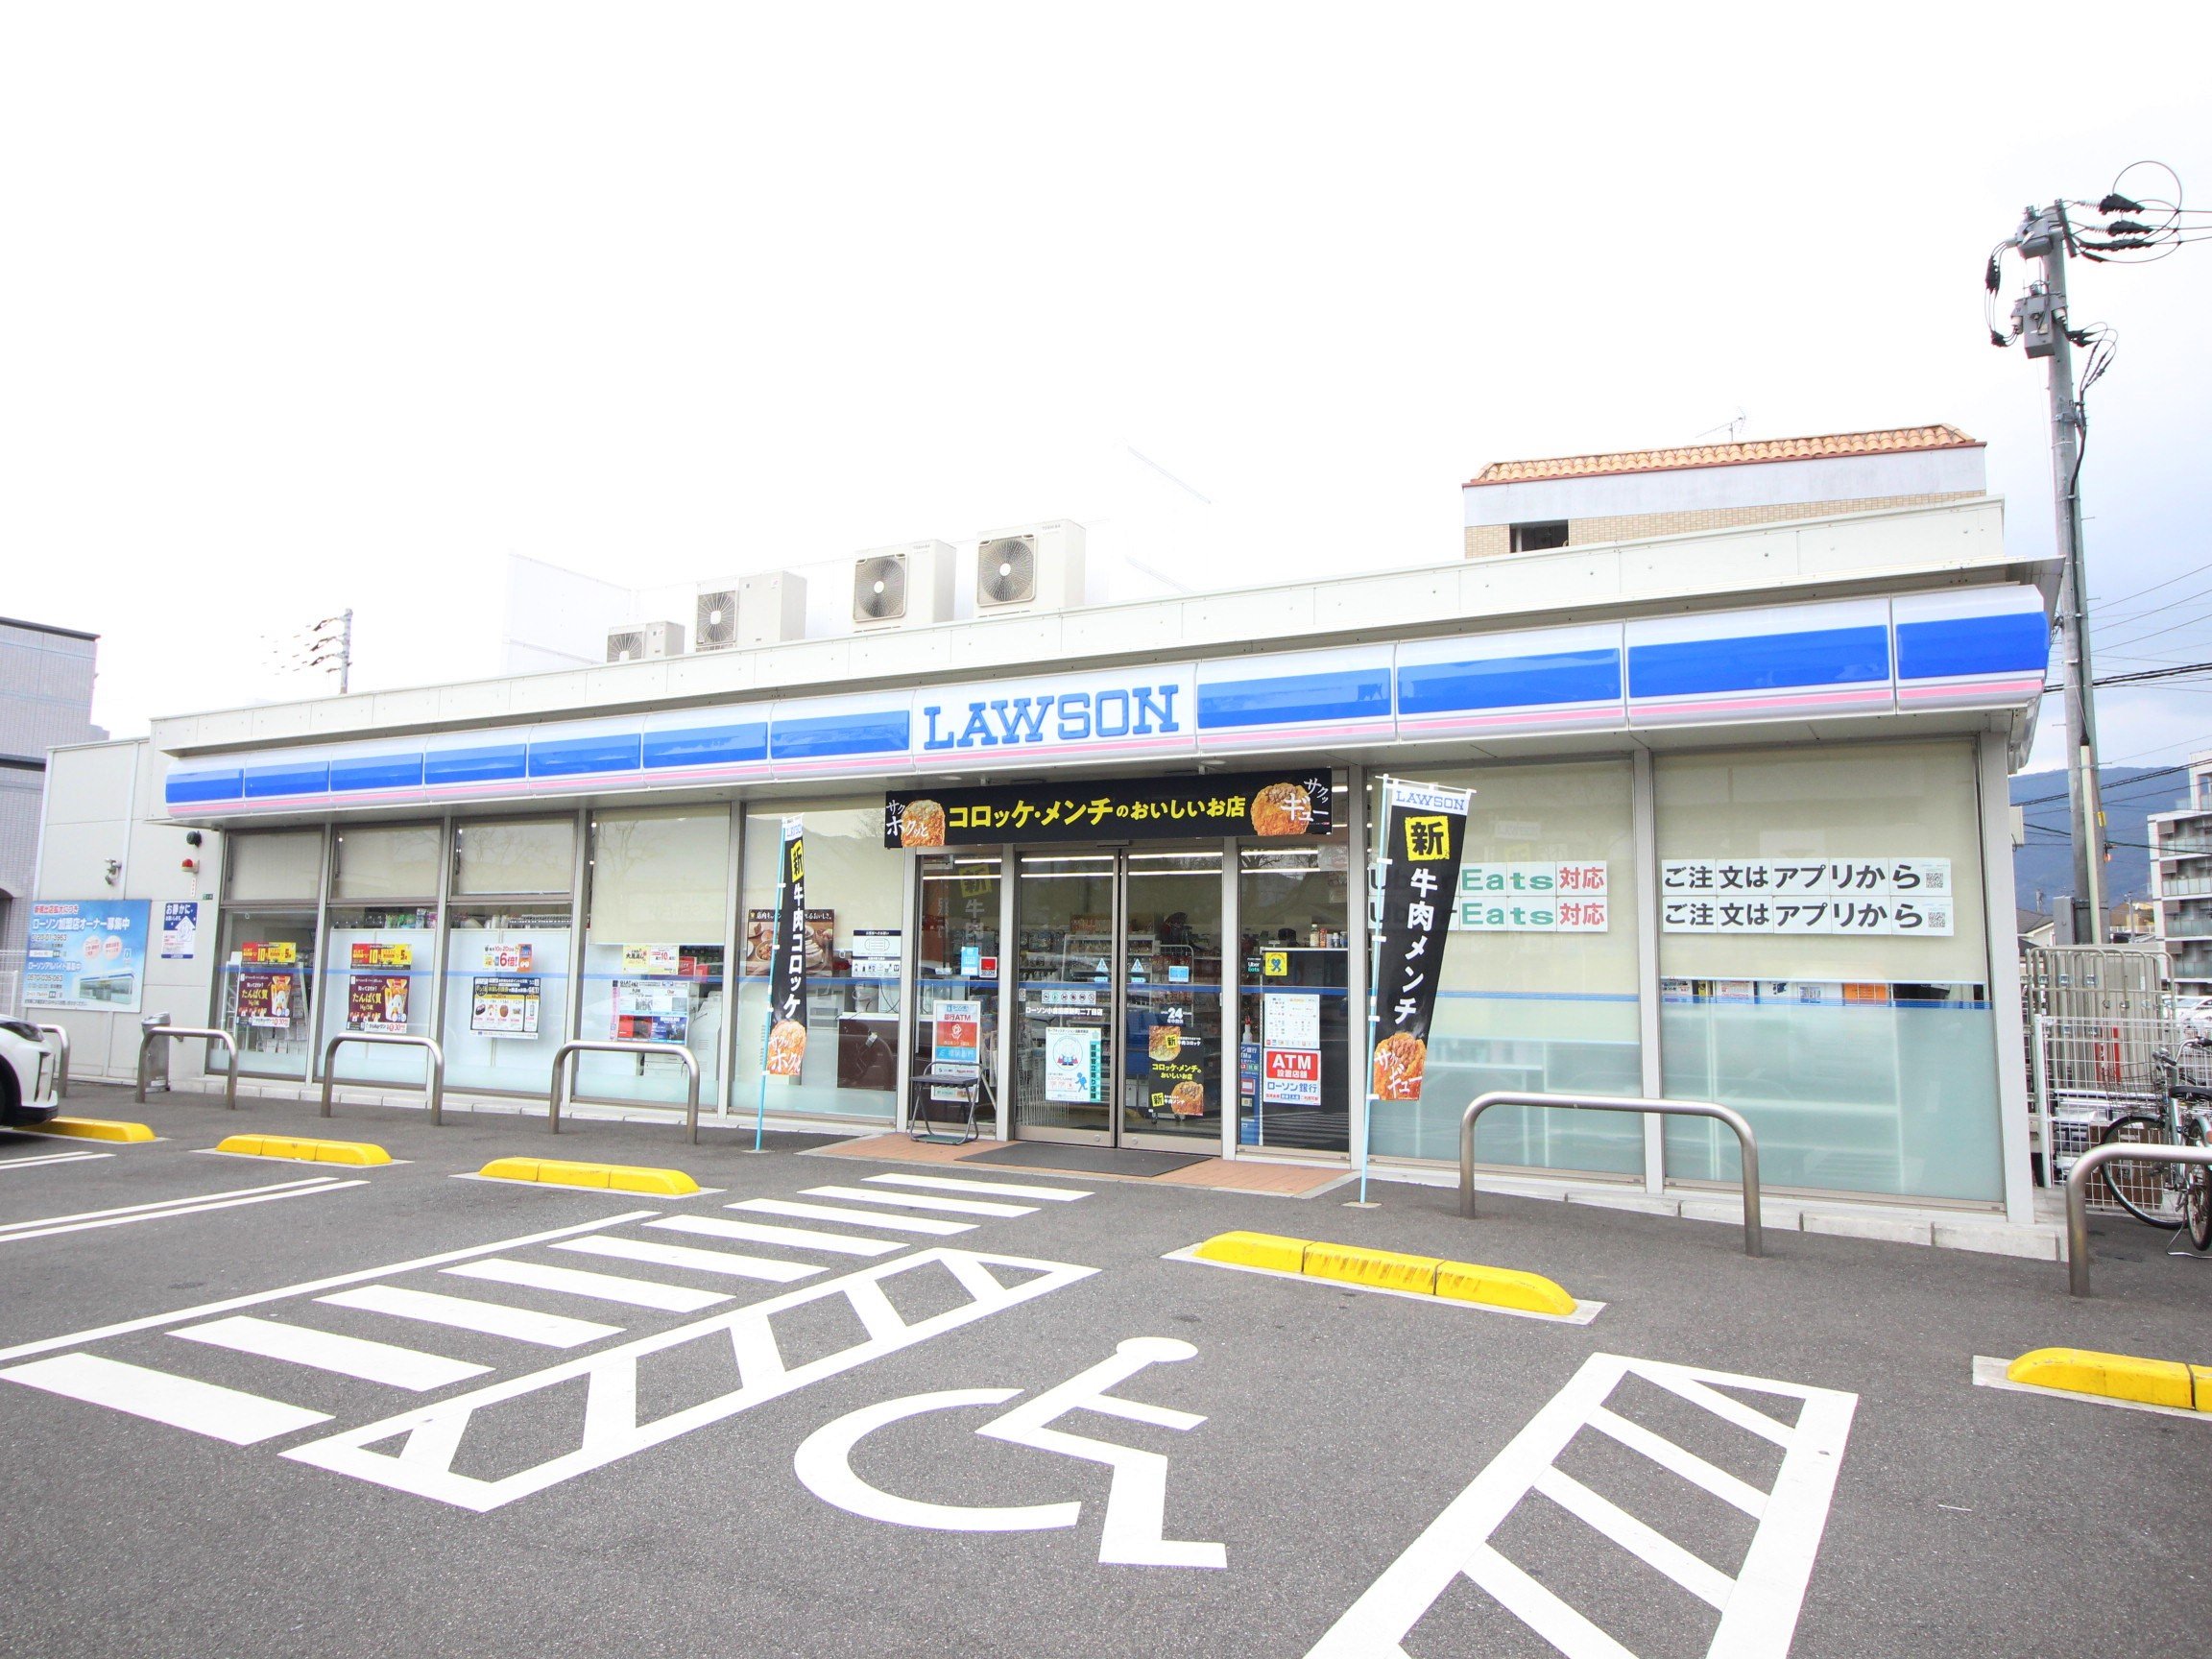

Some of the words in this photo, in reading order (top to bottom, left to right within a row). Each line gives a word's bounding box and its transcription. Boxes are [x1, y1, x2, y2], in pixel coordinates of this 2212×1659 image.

[924, 684, 1179, 750] LAWSON
[1396, 790, 1465, 811] LAWSON
[1410, 822, 1444, 855] 新
[793, 846, 804, 877] 新
[1461, 869, 1553, 890] Eats
[1559, 866, 1604, 890] 対応
[1665, 864, 1921, 889] ご注文はアプリから
[33, 917, 131, 931] ローソン加盟店オーナー募集中
[1461, 902, 1553, 925] Eats
[1559, 902, 1604, 926] 対応
[1665, 902, 1923, 928] ご注文はアプリから
[783, 882, 805, 1019] 牛肉コロッケ
[1394, 868, 1438, 1024] 牛肉メンチ
[1167, 1007, 1183, 1020] 24
[1167, 1036, 1176, 1046] 新
[1272, 1053, 1311, 1070] ATM
[1277, 1070, 1308, 1079] 設置店舗
[1154, 1094, 1164, 1105] 新
[1267, 1082, 1317, 1094] ローソン銀行
